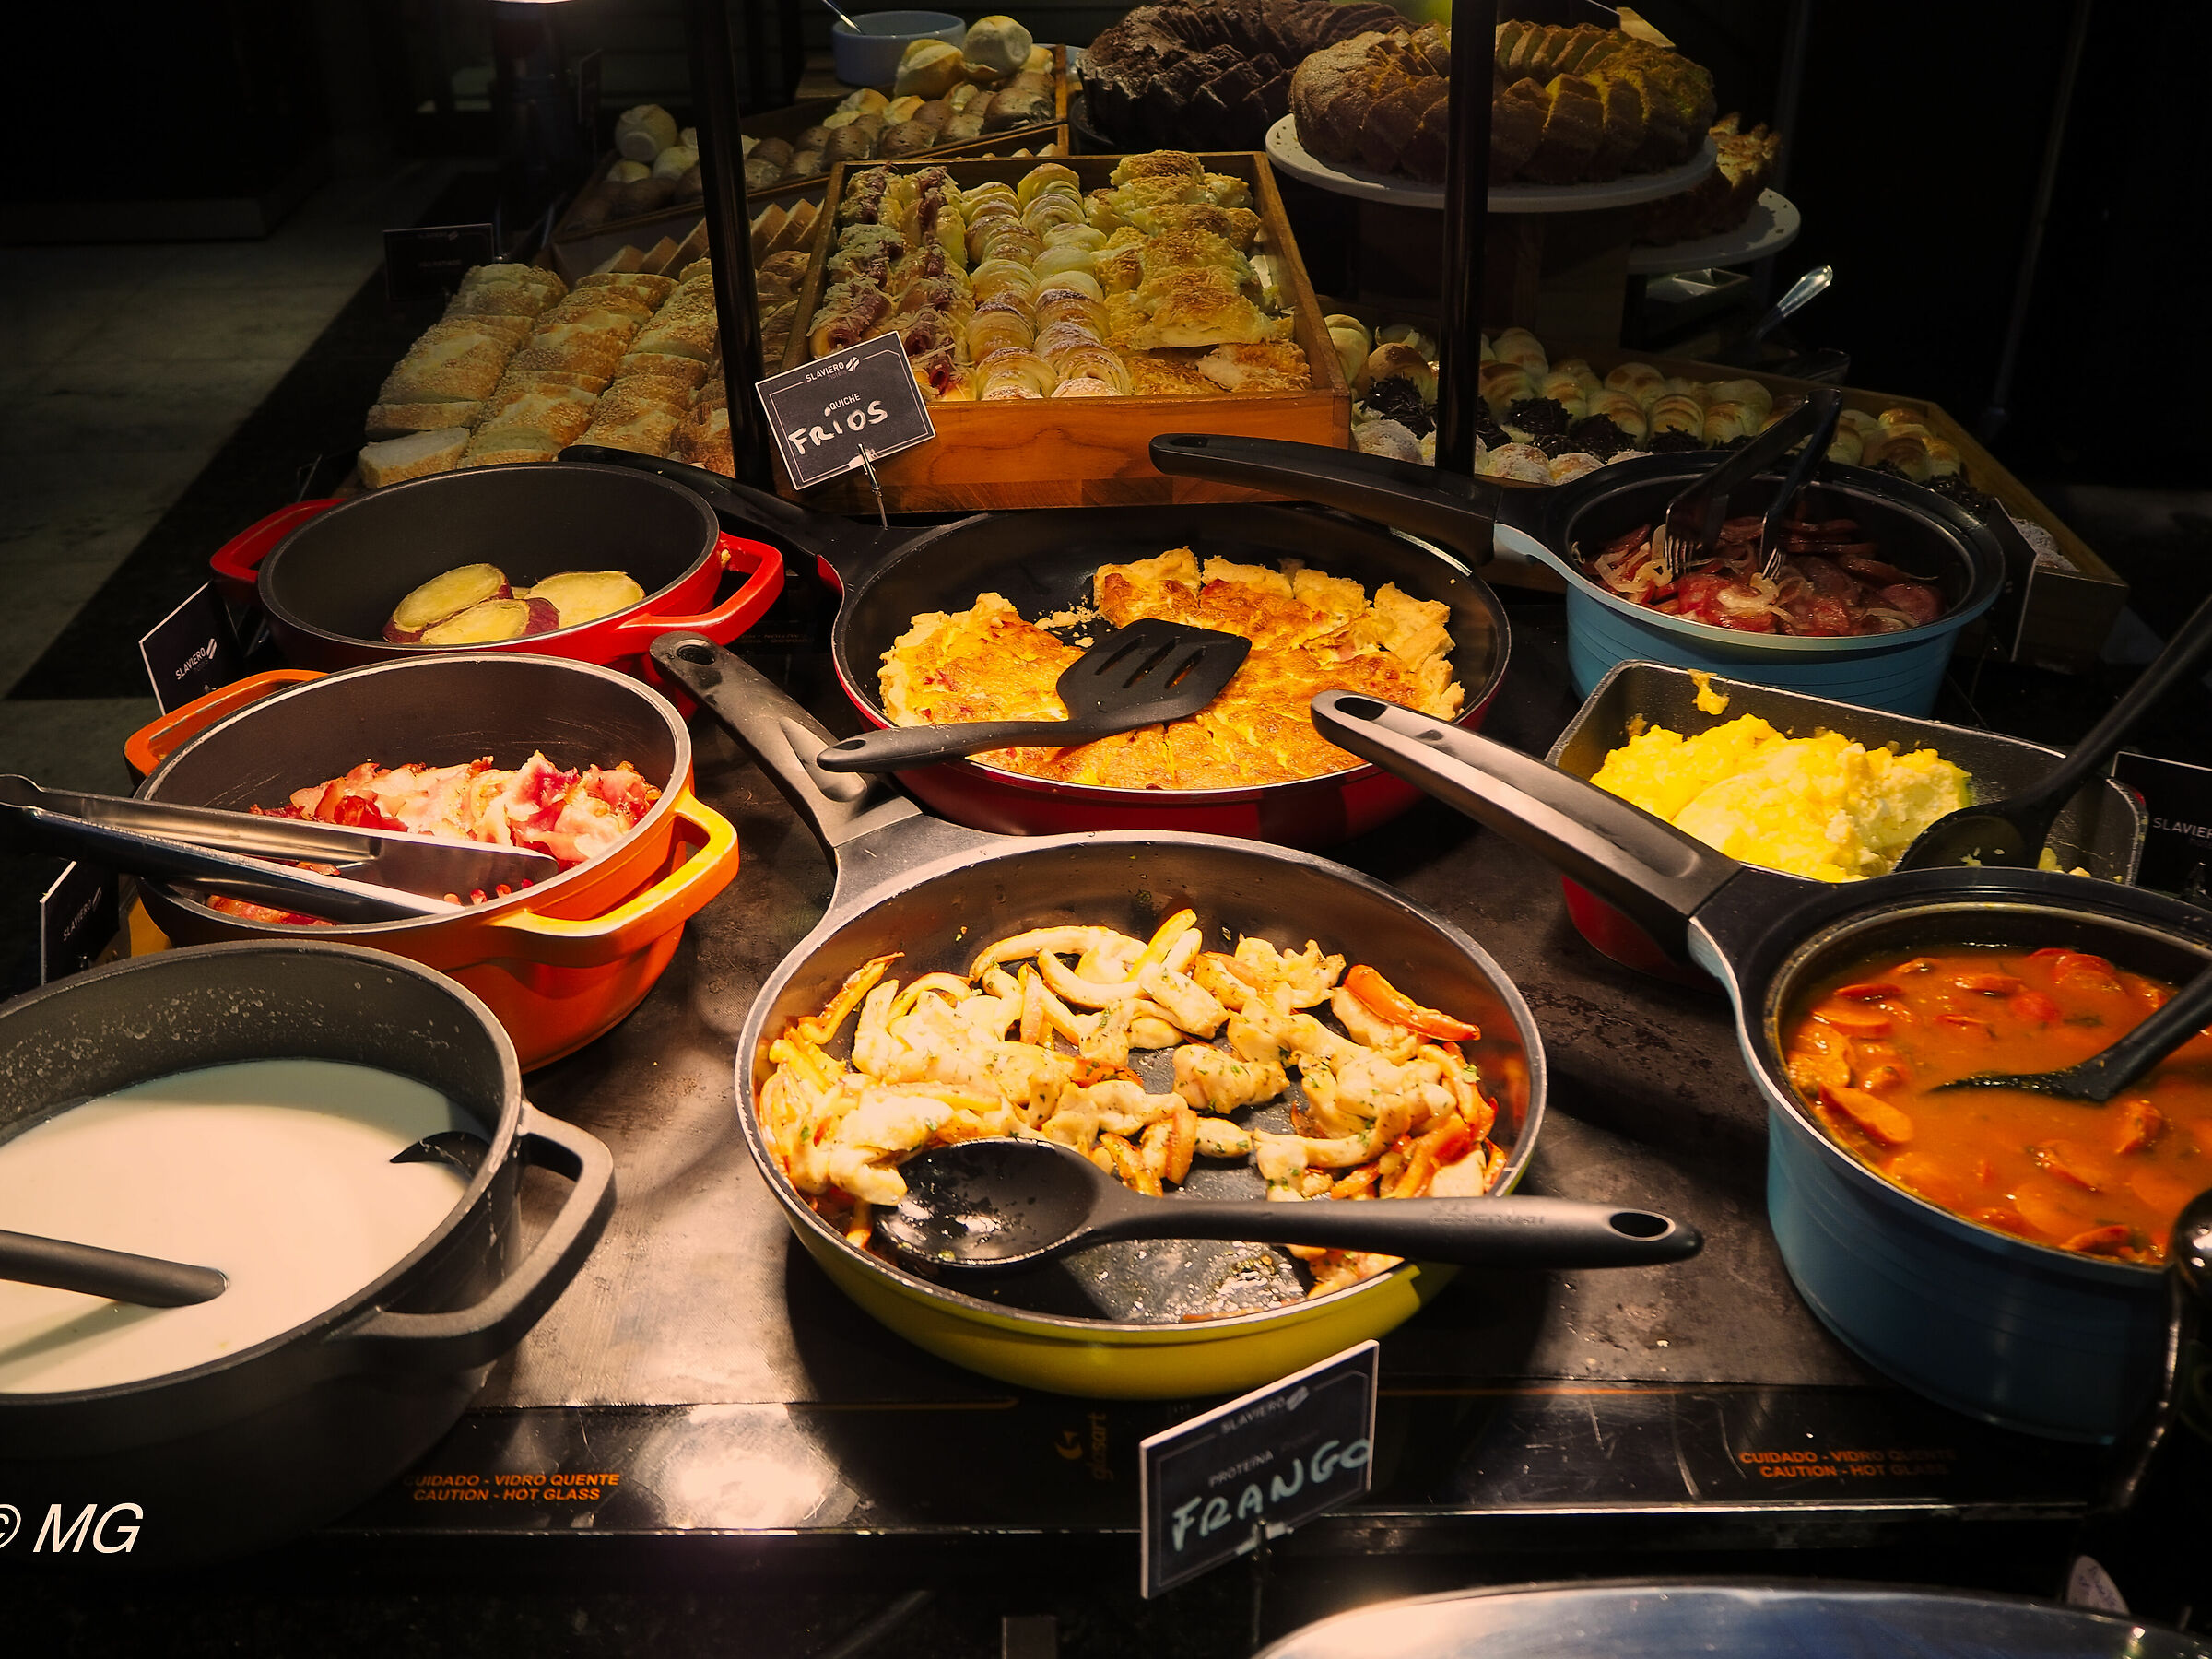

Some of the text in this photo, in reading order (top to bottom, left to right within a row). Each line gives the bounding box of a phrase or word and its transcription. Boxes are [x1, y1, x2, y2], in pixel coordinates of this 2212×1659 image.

[806, 361, 845, 382] SLAVIERO
[830, 393, 861, 410] QUICHE
[788, 400, 888, 455] FRIOS
[175, 647, 206, 680] SLAVIERO
[1219, 1395, 1287, 1434] SLAVIERO
[1739, 1450, 1819, 1464] CUIDADO
[1830, 1450, 1886, 1463] VIDRO
[1759, 1465, 1838, 1477] CAUTION
[1850, 1464, 1887, 1477] HOT
[402, 1475, 481, 1488] CUIDADO
[494, 1474, 547, 1487] VIDRO
[549, 1473, 620, 1487] QUENTE
[413, 1488, 489, 1501] CAUTION
[502, 1488, 540, 1500] HOT
[542, 1488, 601, 1500] GLASS
[1172, 1437, 1371, 1552] FRANGO
